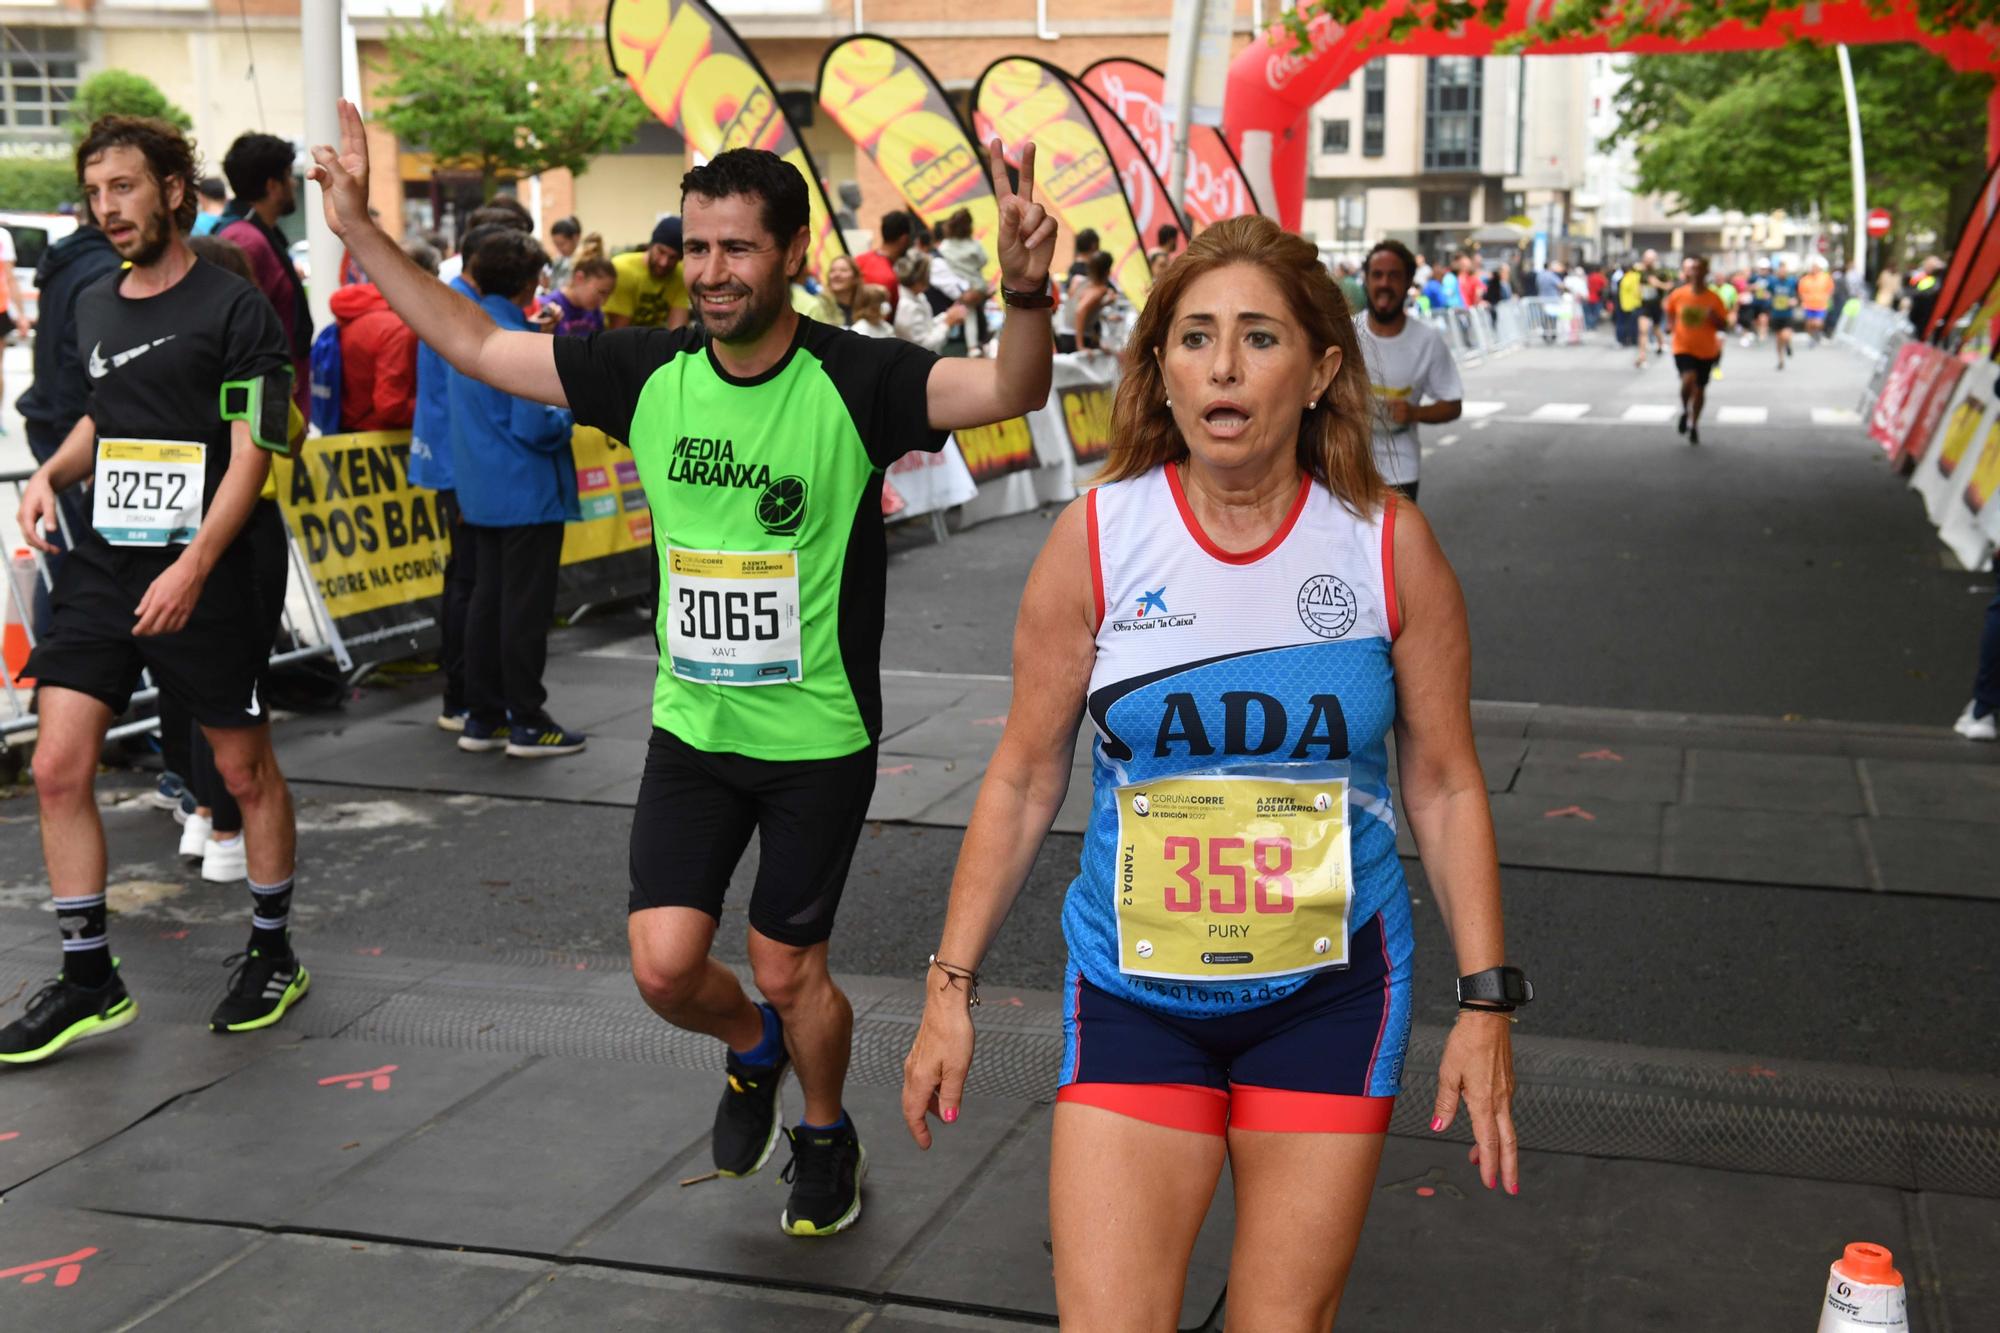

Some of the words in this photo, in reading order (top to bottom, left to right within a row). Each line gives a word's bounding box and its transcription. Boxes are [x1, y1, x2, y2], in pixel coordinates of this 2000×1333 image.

[672, 435, 734, 463] MEDIA
[290, 453, 316, 506] A
[321, 444, 415, 500] XENT
[667, 457, 771, 489] LARANXA
[107, 470, 186, 511] 3252
[300, 504, 380, 564] DOS
[679, 587, 779, 641] 3065
[1113, 623, 1131, 632] Obra
[1132, 620, 1155, 631] Social
[712, 647, 737, 658] XAVI
[1161, 811, 1188, 819] EDICIÓN
[1123, 844, 1135, 893] TANDA
[1164, 836, 1294, 914] 358
[1123, 897, 1133, 906] 2
[1208, 924, 1250, 938] PURY
